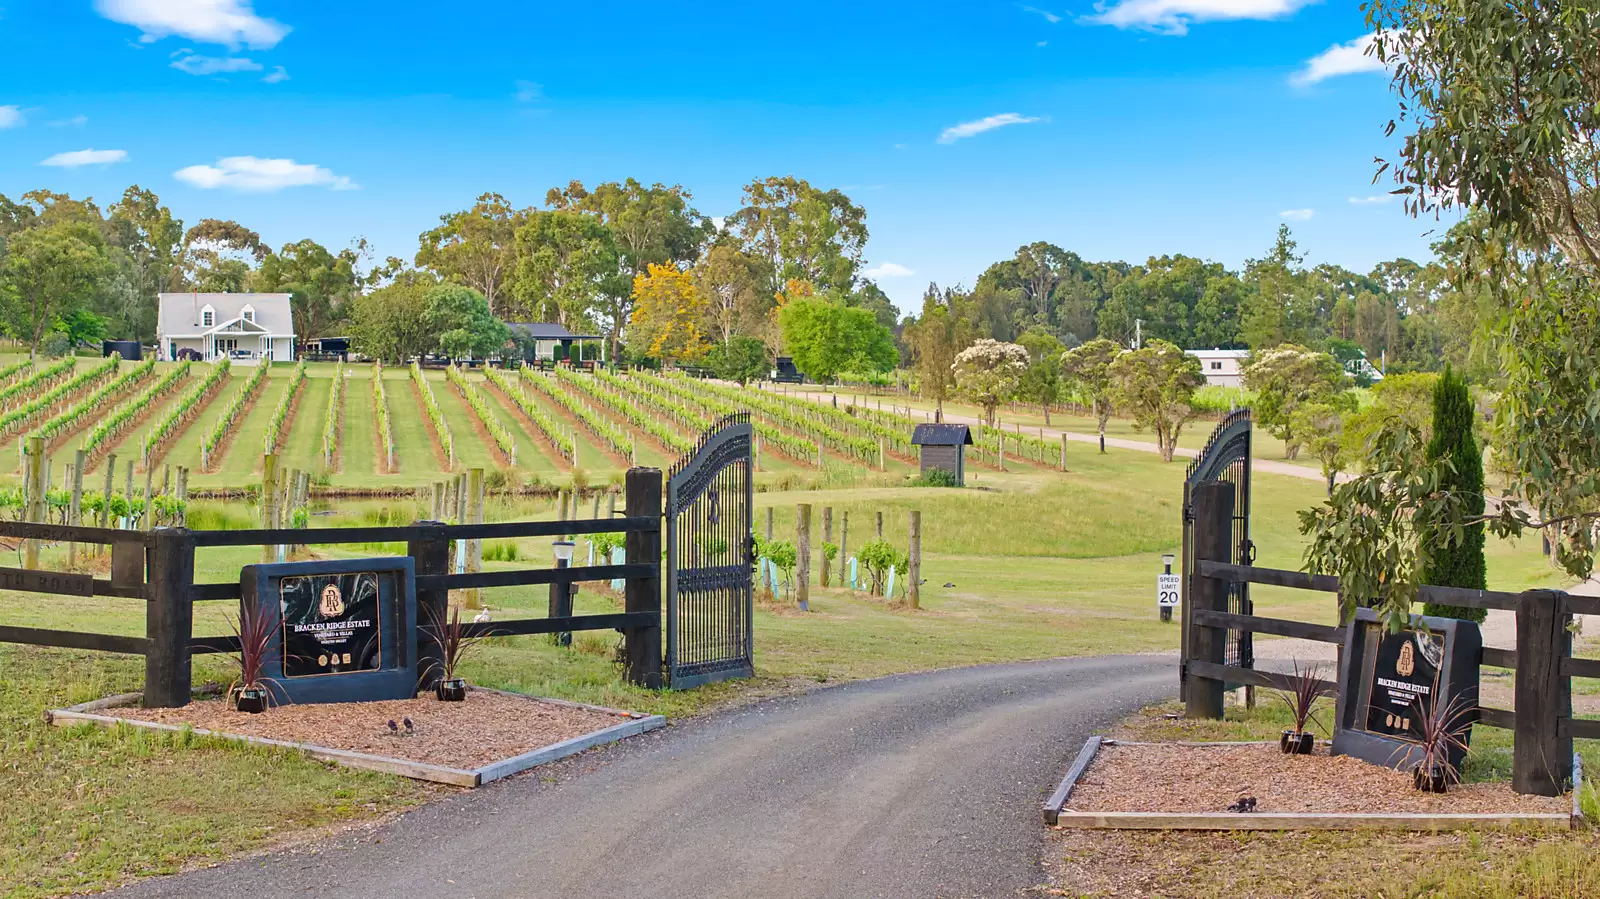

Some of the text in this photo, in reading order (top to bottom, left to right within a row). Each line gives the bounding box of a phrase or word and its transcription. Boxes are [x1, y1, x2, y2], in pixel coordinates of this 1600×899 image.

[1160, 591, 1178, 604] 20
[294, 620, 371, 632] BRACKEN RIDGE ESTATE
[1377, 677, 1430, 694] BRACKEN RIDGE ESTATE
